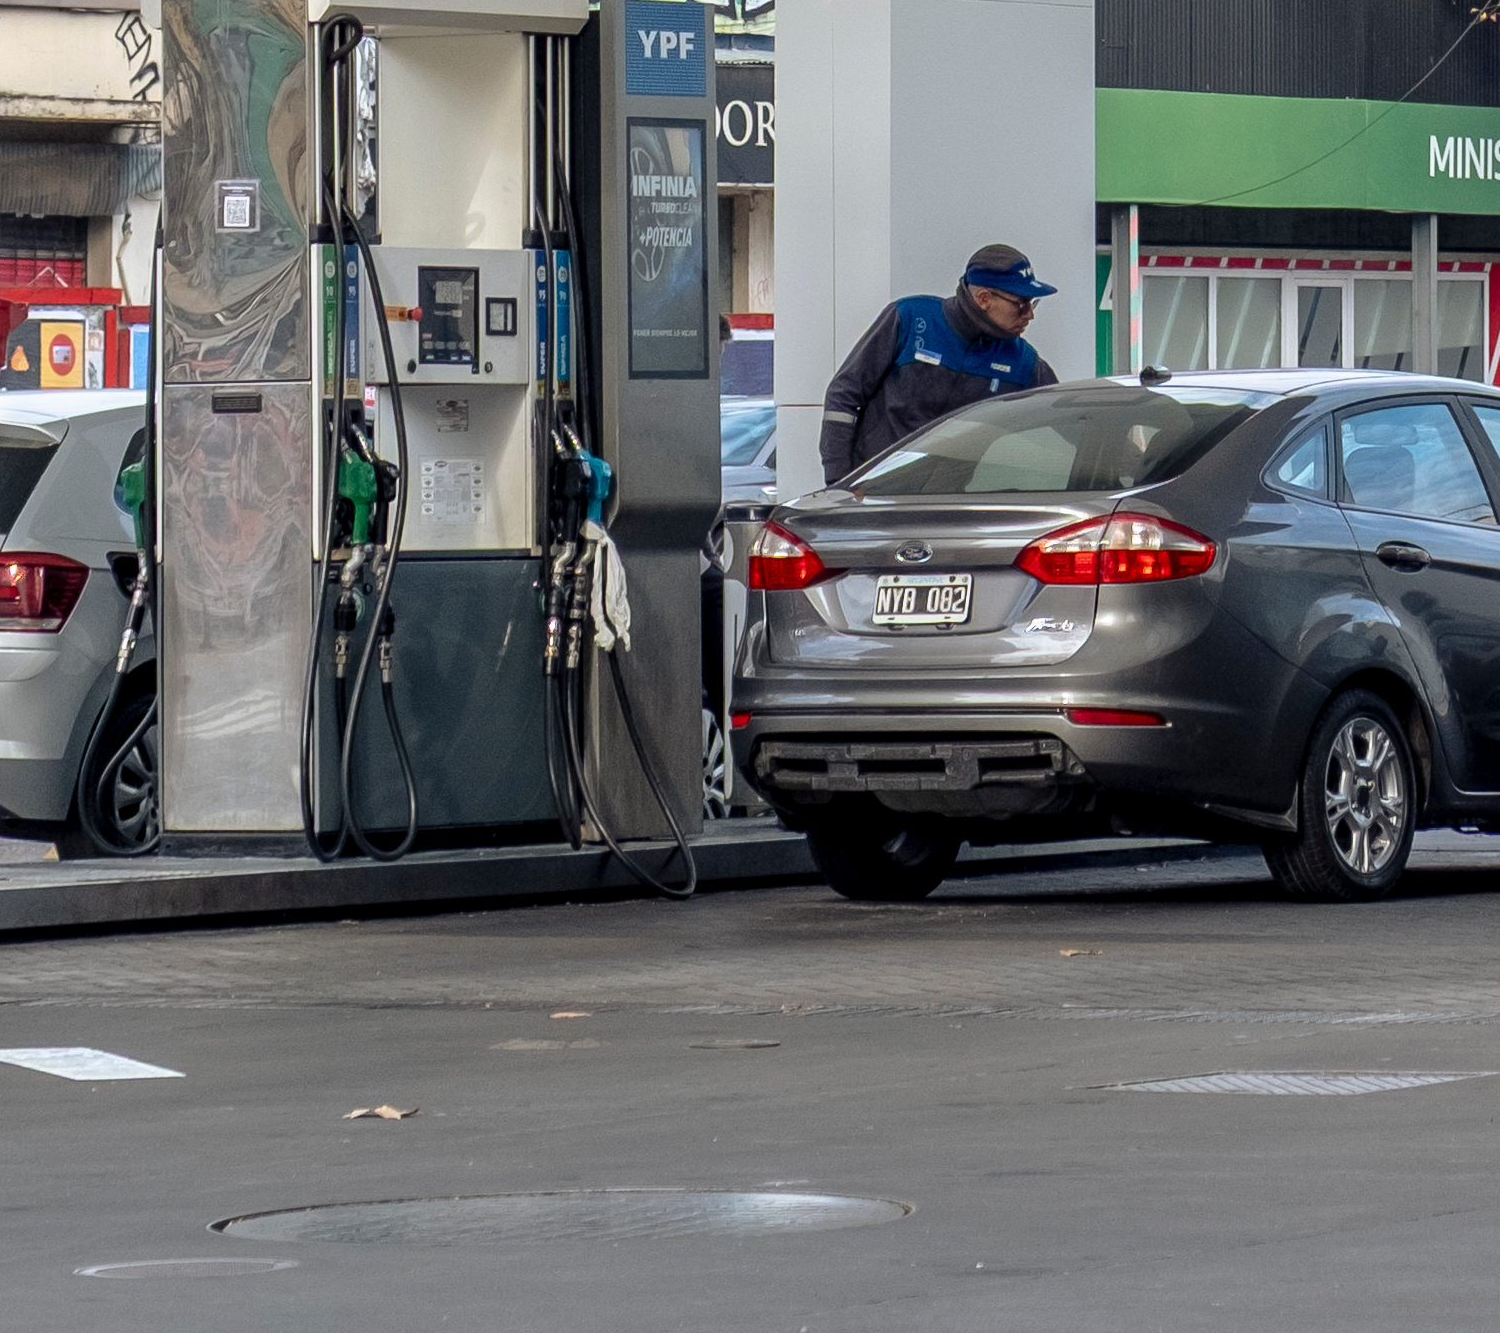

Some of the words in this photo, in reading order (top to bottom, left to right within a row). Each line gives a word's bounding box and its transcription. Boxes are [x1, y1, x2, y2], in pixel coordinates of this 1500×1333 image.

[637, 30, 696, 60] YPF
[715, 100, 775, 146] OR
[632, 175, 697, 198] INFINIA
[926, 587, 967, 614] 082
